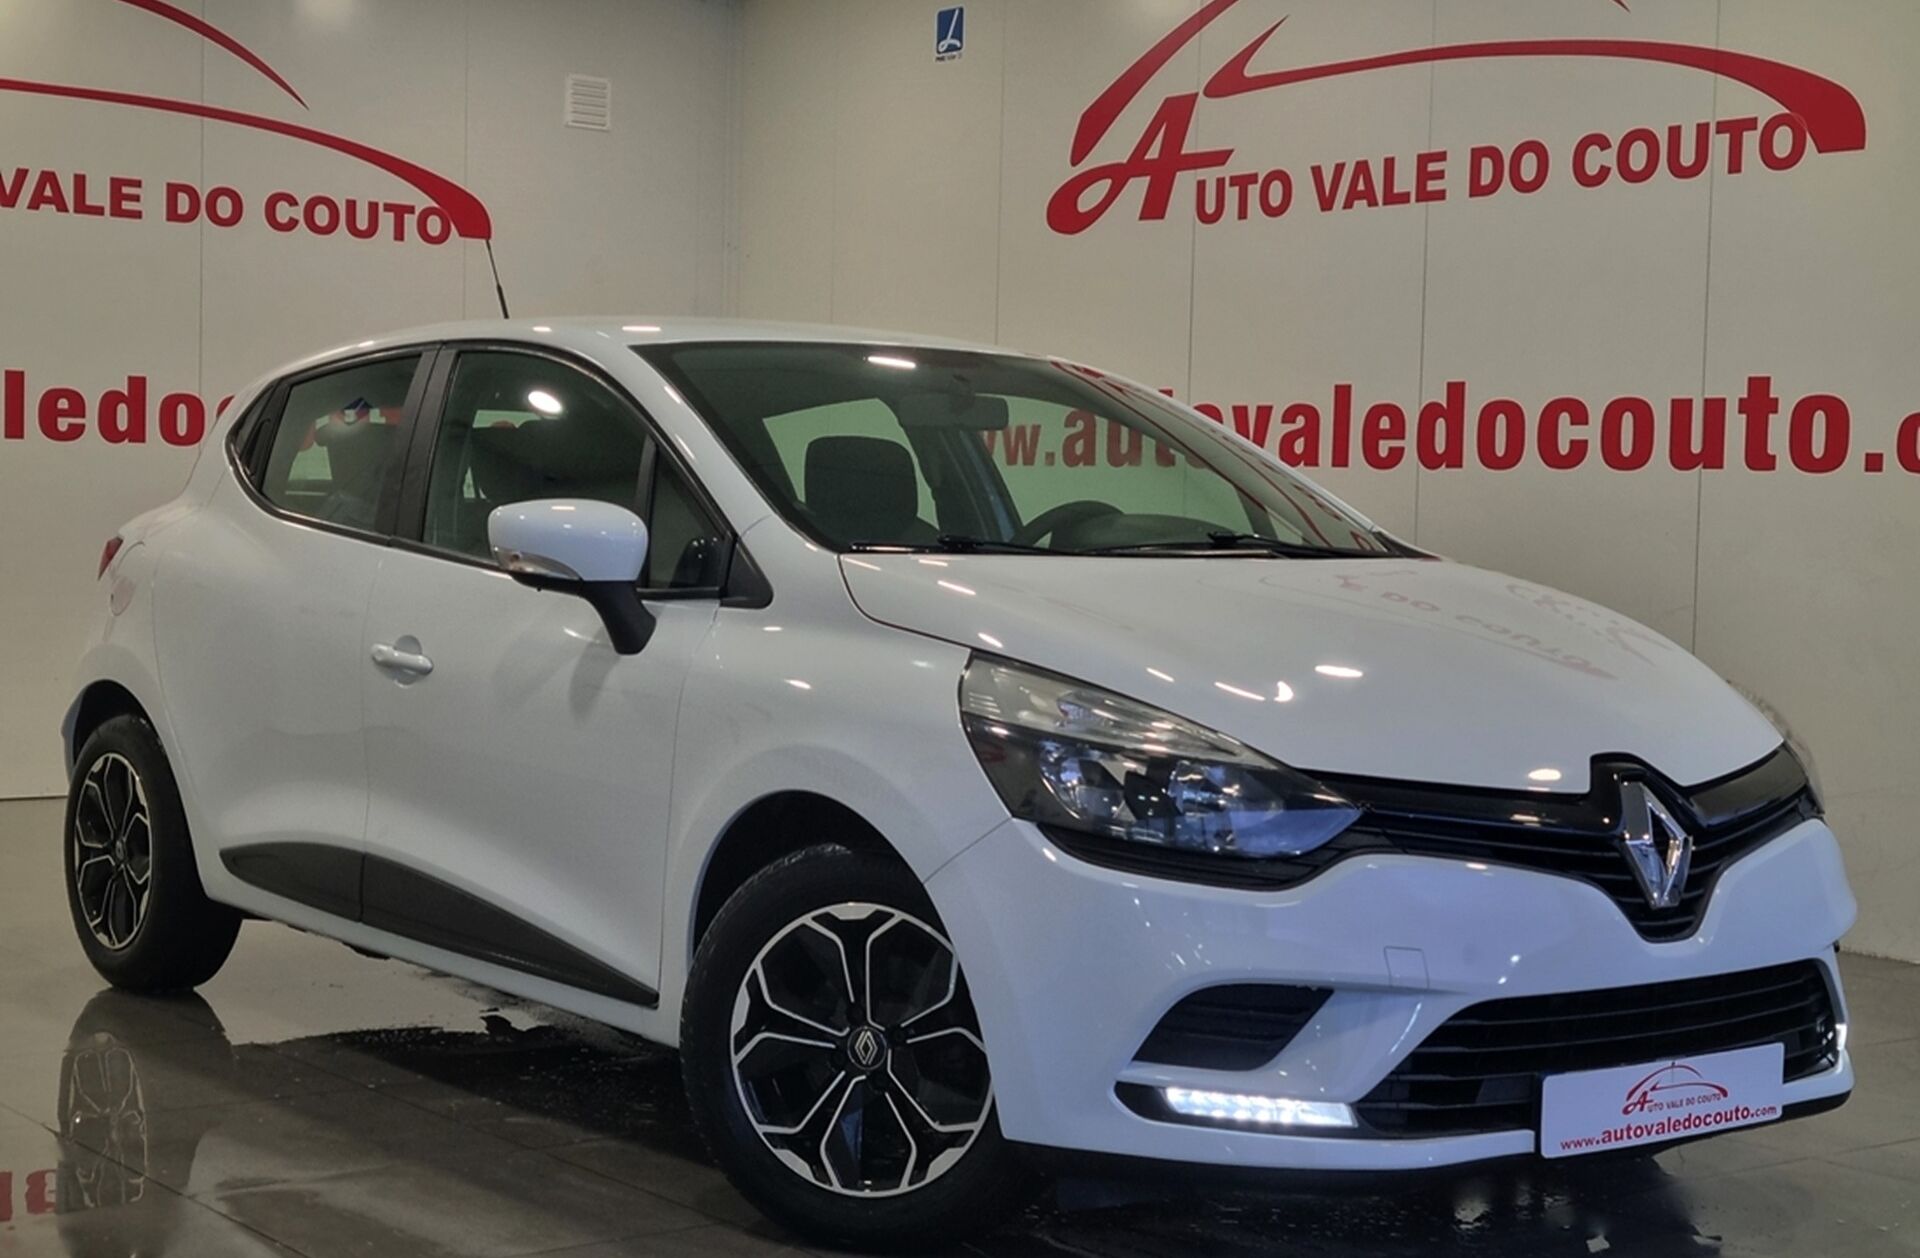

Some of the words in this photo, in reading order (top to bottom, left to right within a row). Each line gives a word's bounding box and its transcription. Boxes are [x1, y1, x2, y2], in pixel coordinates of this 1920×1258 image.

[1046, 92, 1293, 235] AUTO
[1310, 150, 1448, 213] VALE
[1468, 139, 1550, 199] DO
[1571, 112, 1808, 189] COUTO
[0, 167, 143, 221] VALE
[165, 181, 245, 228] DO
[263, 192, 453, 246] COUTO
[4, 369, 235, 447] ledo
[1560, 1104, 1778, 1151] www.autovaledocouto.com
[1666, 1099, 1684, 1110] VALE
[1685, 1096, 1696, 1107] DO
[1697, 1092, 1722, 1105] COUTO
